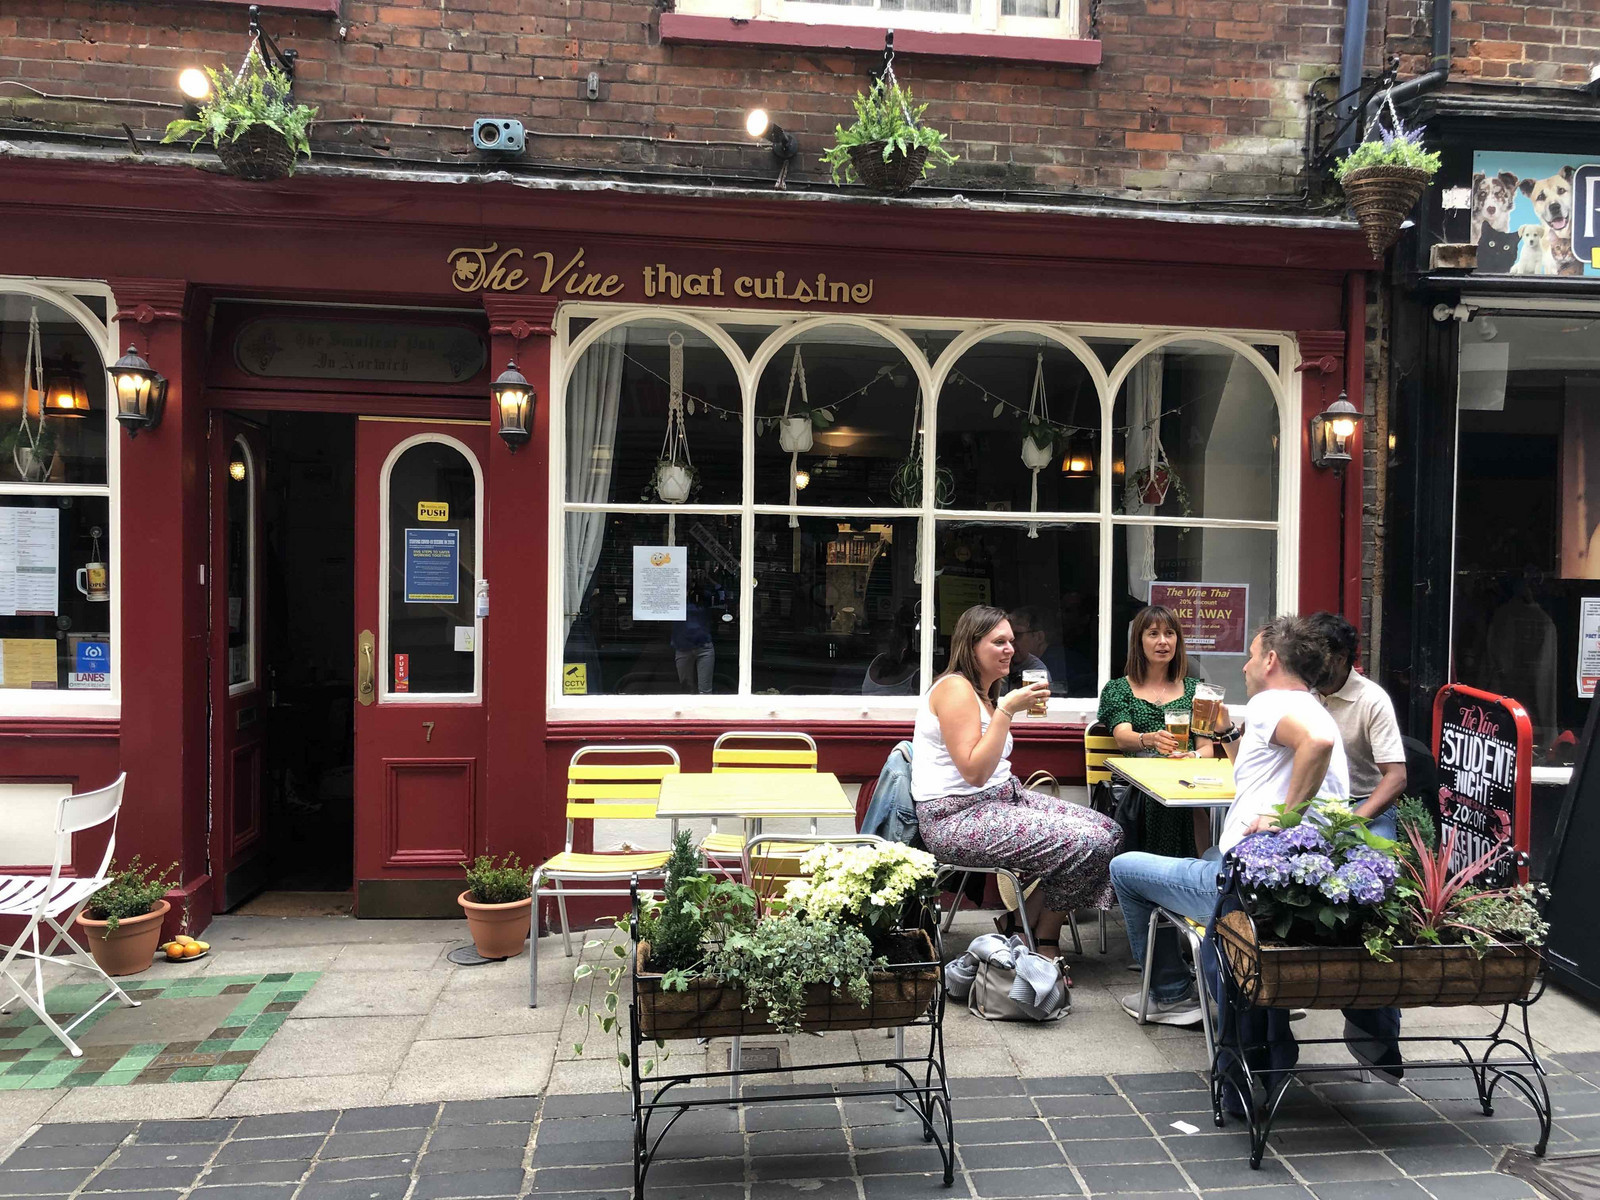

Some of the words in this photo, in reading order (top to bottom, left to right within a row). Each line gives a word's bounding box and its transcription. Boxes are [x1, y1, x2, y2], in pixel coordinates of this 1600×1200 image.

[447, 242, 530, 293] The
[533, 247, 624, 297] Vine
[643, 264, 726, 299] thai
[734, 270, 874, 304] cuisine
[340, 352, 409, 373] Norwich
[420, 508, 446, 517] PUSH
[1166, 588, 1184, 597] The
[1187, 588, 1207, 598] Vine
[1210, 589, 1231, 598] Thai
[1172, 608, 1193, 618] AKE
[1197, 609, 1232, 620] AWAY
[76, 673, 105, 682] LANES
[422, 721, 435, 742] 7
[1459, 705, 1478, 732] The
[1477, 706, 1500, 738] Vine
[1443, 729, 1514, 787] STUDENT
[1455, 769, 1491, 806] NIGHT
[1452, 803, 1474, 825] 20%
[1473, 811, 1487, 831] OFF
[1497, 859, 1511, 878] OFF
